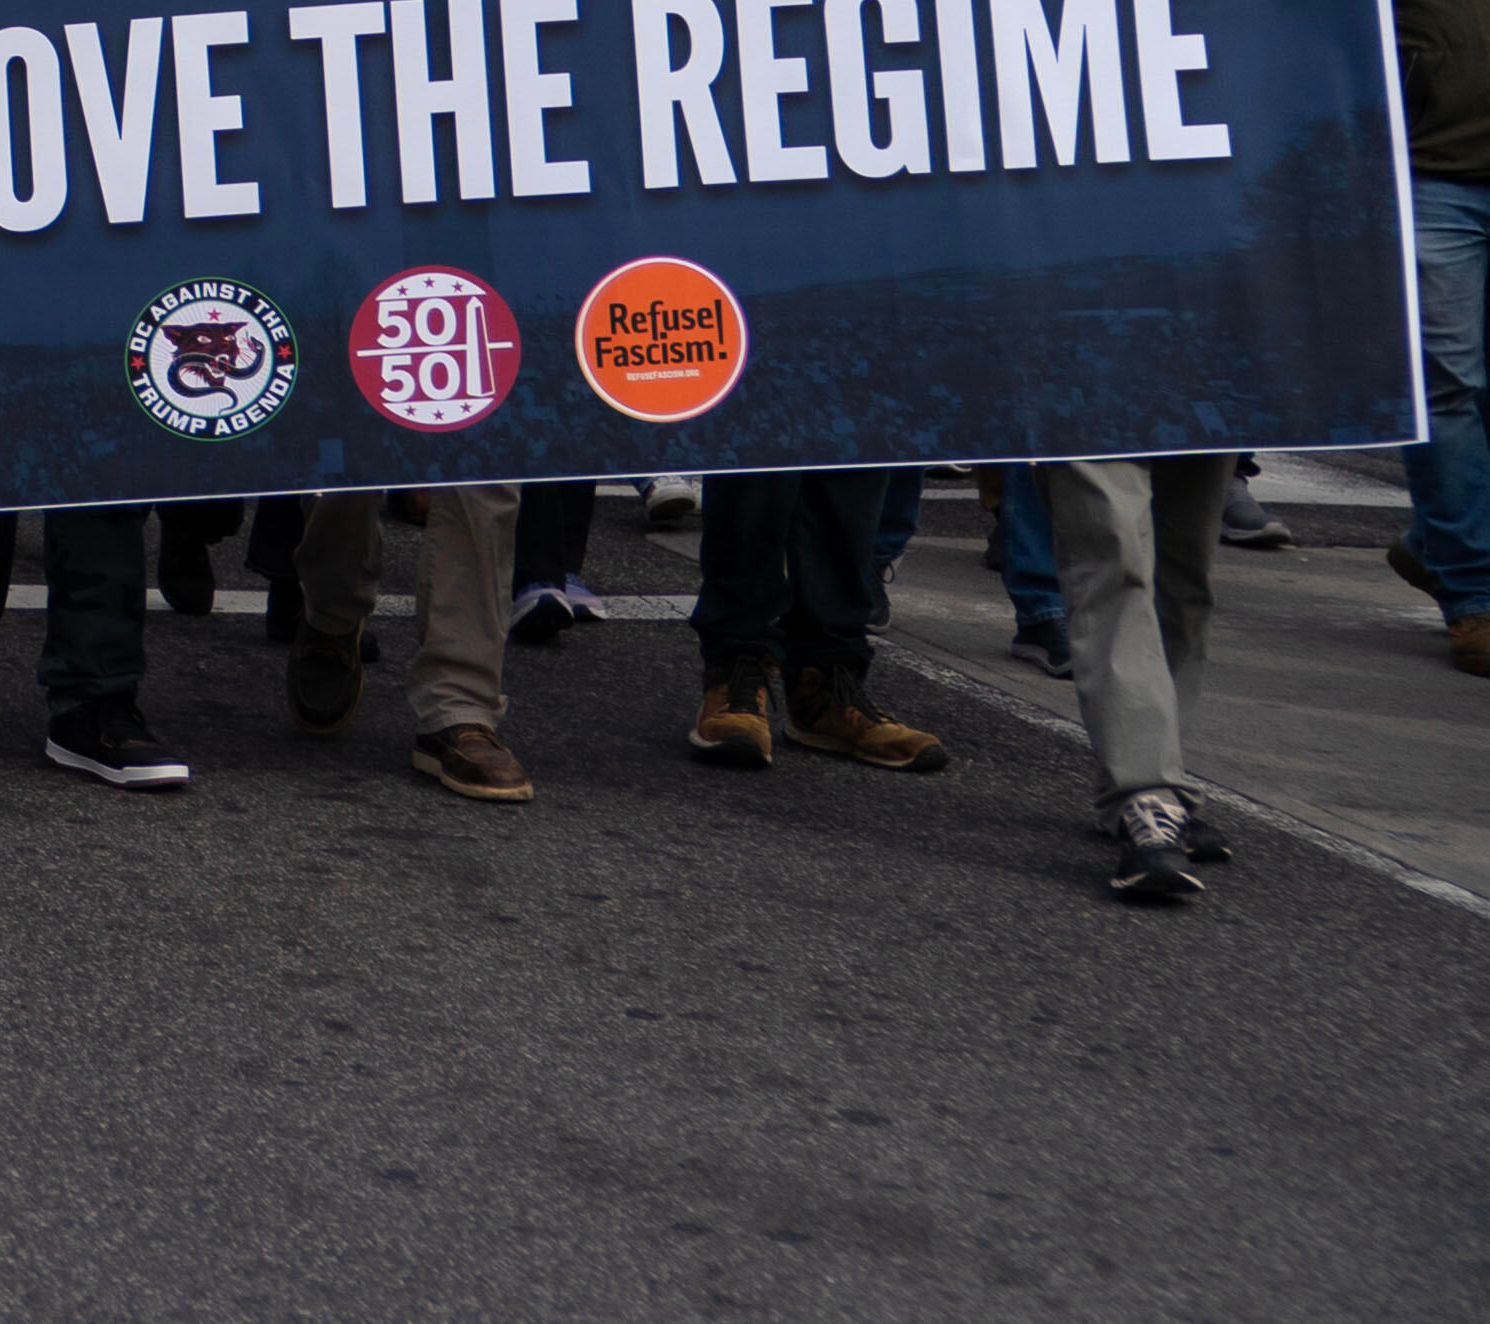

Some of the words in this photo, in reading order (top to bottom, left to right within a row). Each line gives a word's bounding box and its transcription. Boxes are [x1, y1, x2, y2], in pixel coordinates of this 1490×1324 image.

[129, 320, 154, 353] DC
[148, 281, 252, 322] AGAINST
[253, 297, 290, 343] THE
[376, 296, 457, 349] 50
[132, 372, 208, 434] TRUMP
[213, 363, 296, 436] AGENDA
[379, 351, 463, 403] 50
